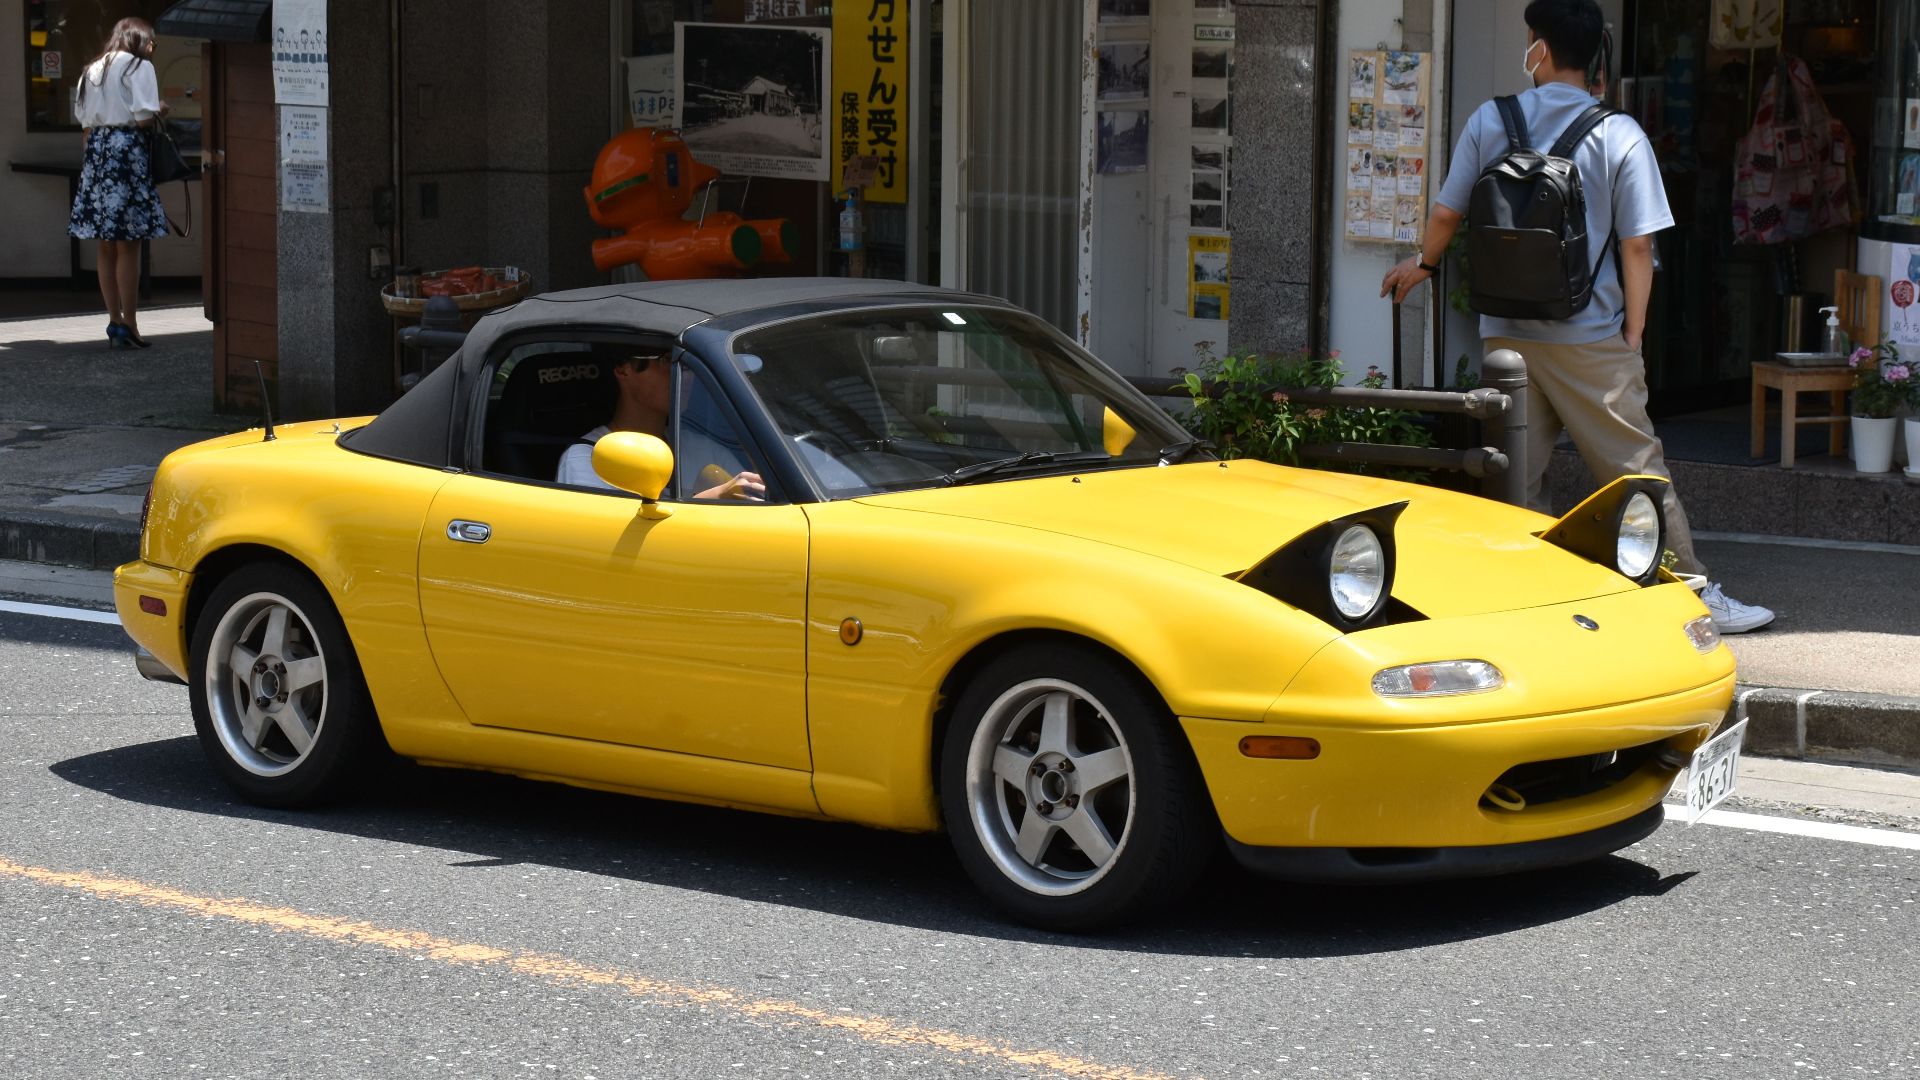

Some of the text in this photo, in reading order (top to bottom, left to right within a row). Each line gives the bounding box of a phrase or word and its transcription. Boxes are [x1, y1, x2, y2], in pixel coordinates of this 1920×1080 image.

[1395, 229, 1415, 241] July
[538, 364, 600, 384] RECARO
[1698, 751, 1736, 811] 86-31
